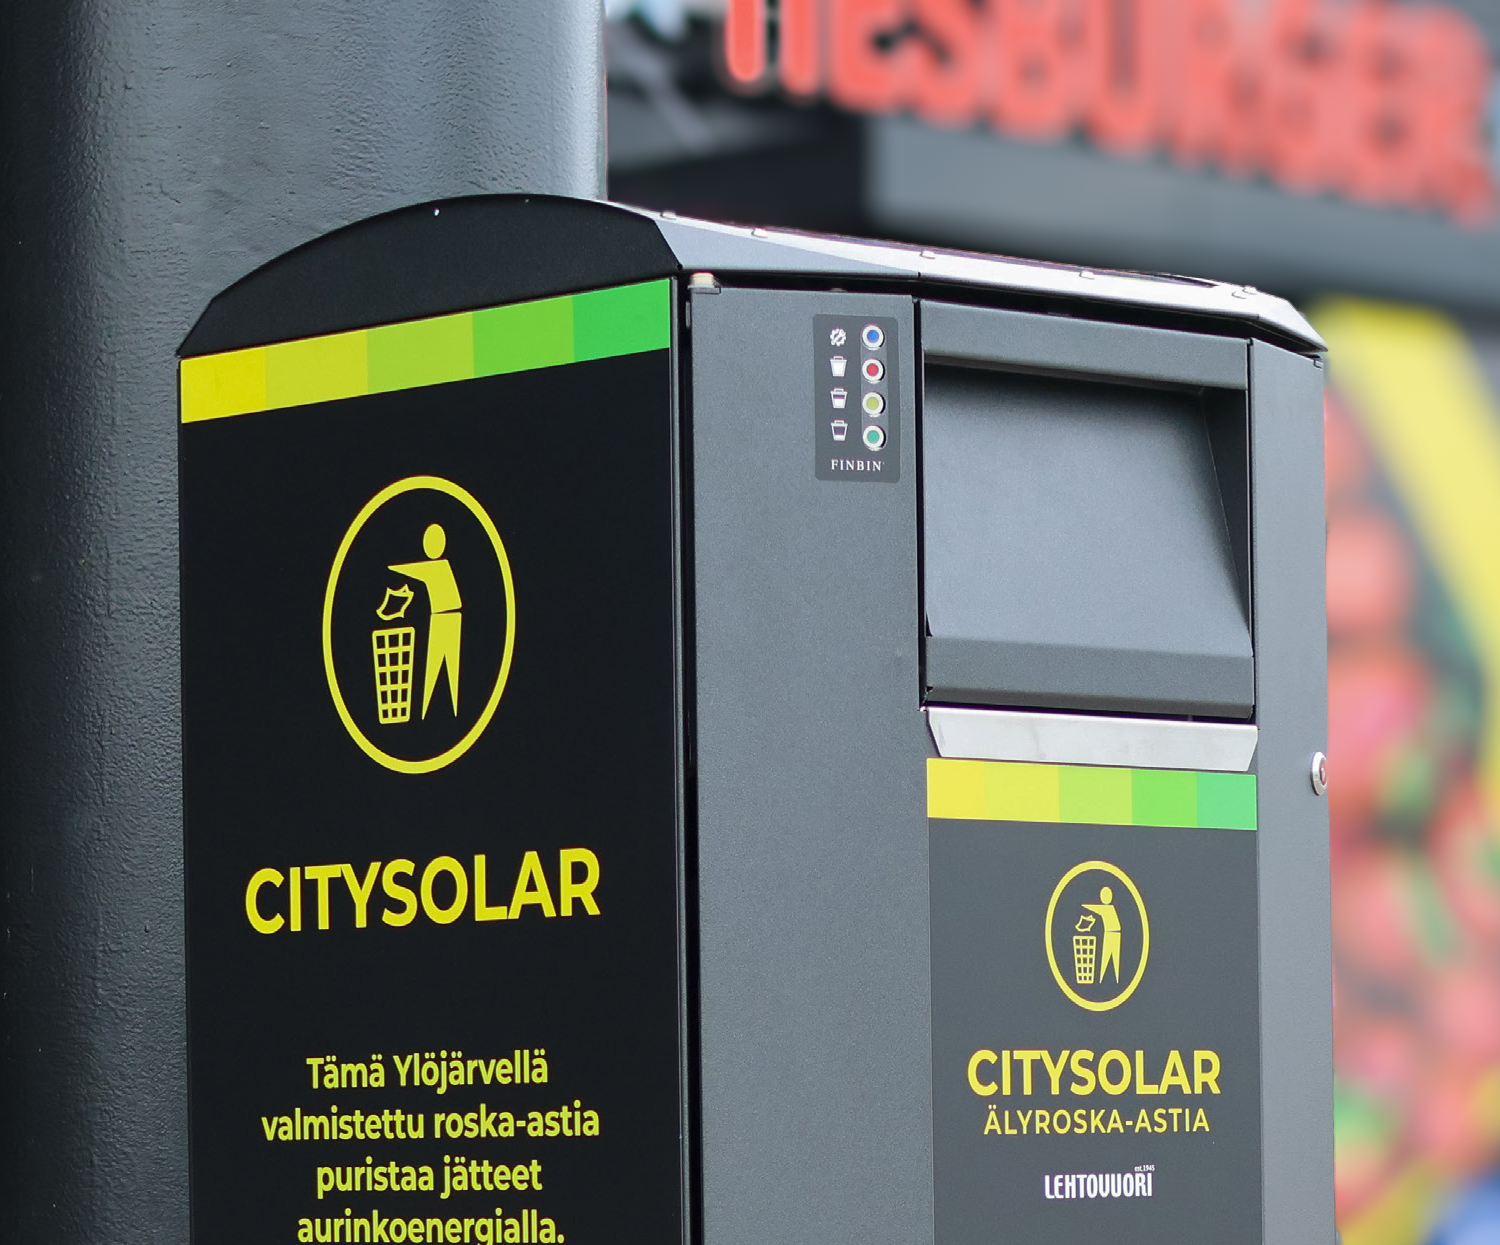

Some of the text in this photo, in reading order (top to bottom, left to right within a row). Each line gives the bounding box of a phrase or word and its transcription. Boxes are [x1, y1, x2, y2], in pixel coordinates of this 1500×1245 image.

[831, 458, 882, 472] FINBIN
[245, 847, 601, 935] CITYSOLAR
[306, 1049, 549, 1094] Tämä Ylöjärvellä
[966, 1049, 1222, 1096] CITYSOLAR
[261, 1100, 600, 1141] valmistettu roska-astia
[983, 1104, 1211, 1135] ÄLYROSKA-ASTIA
[316, 1155, 543, 1200] puristaa jätteet
[1044, 1172, 1153, 1199] LEHTOVUORI
